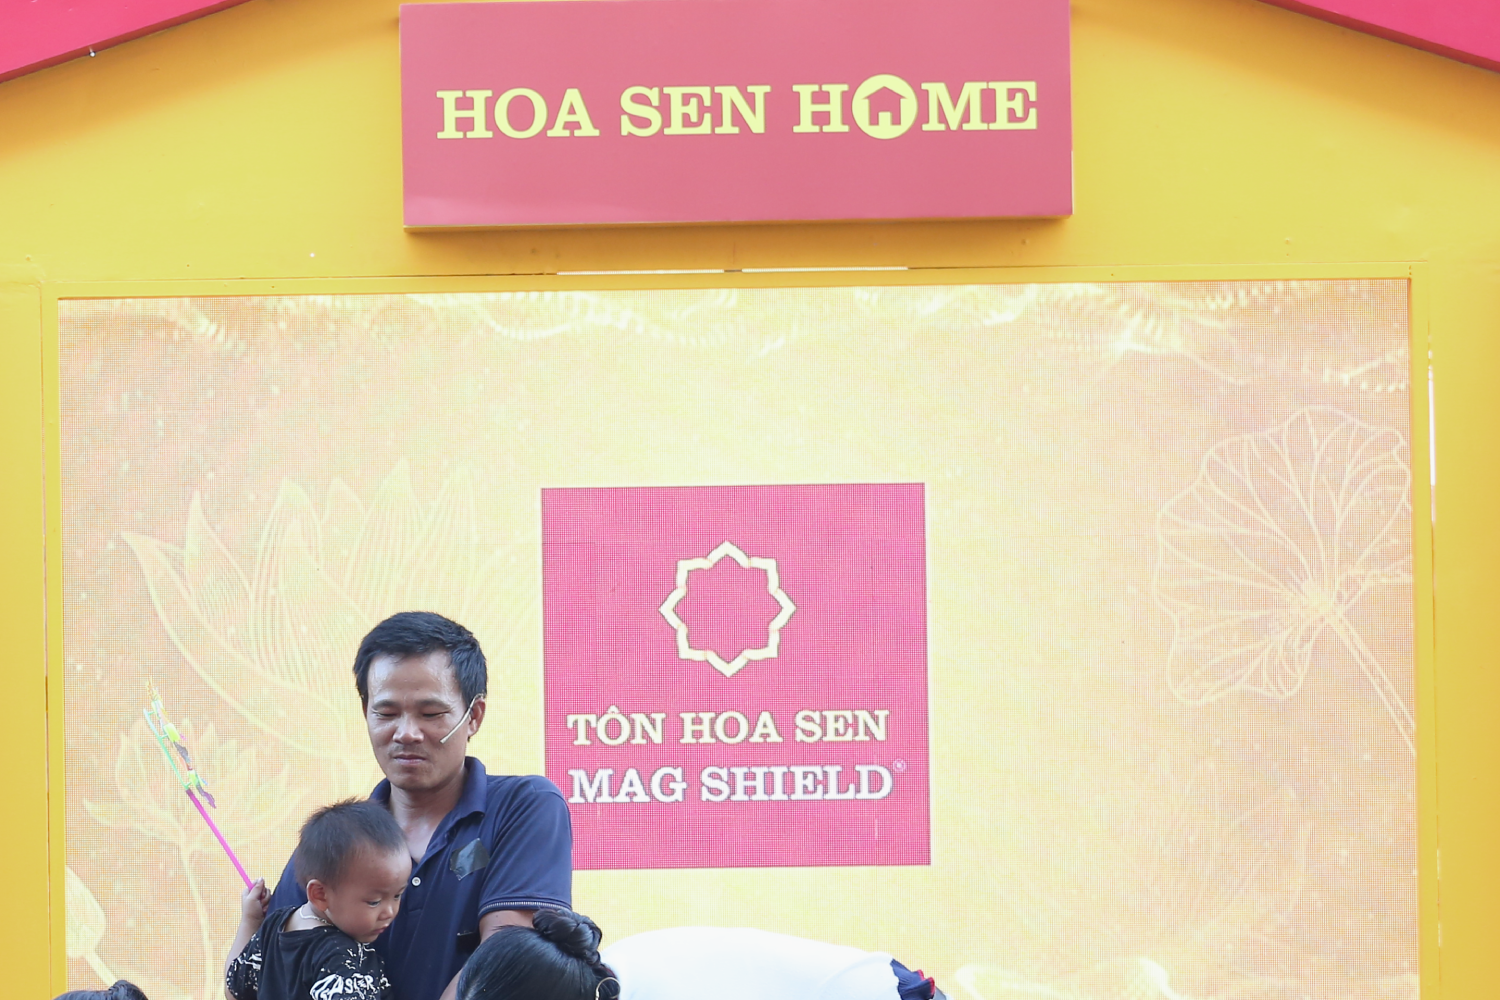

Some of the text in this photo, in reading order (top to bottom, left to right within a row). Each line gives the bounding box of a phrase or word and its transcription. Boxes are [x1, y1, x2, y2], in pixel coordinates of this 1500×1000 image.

[436, 73, 1038, 140] HOA SEN HOME
[566, 705, 890, 746] TÔN HOA SEN
[567, 766, 688, 804] MAG
